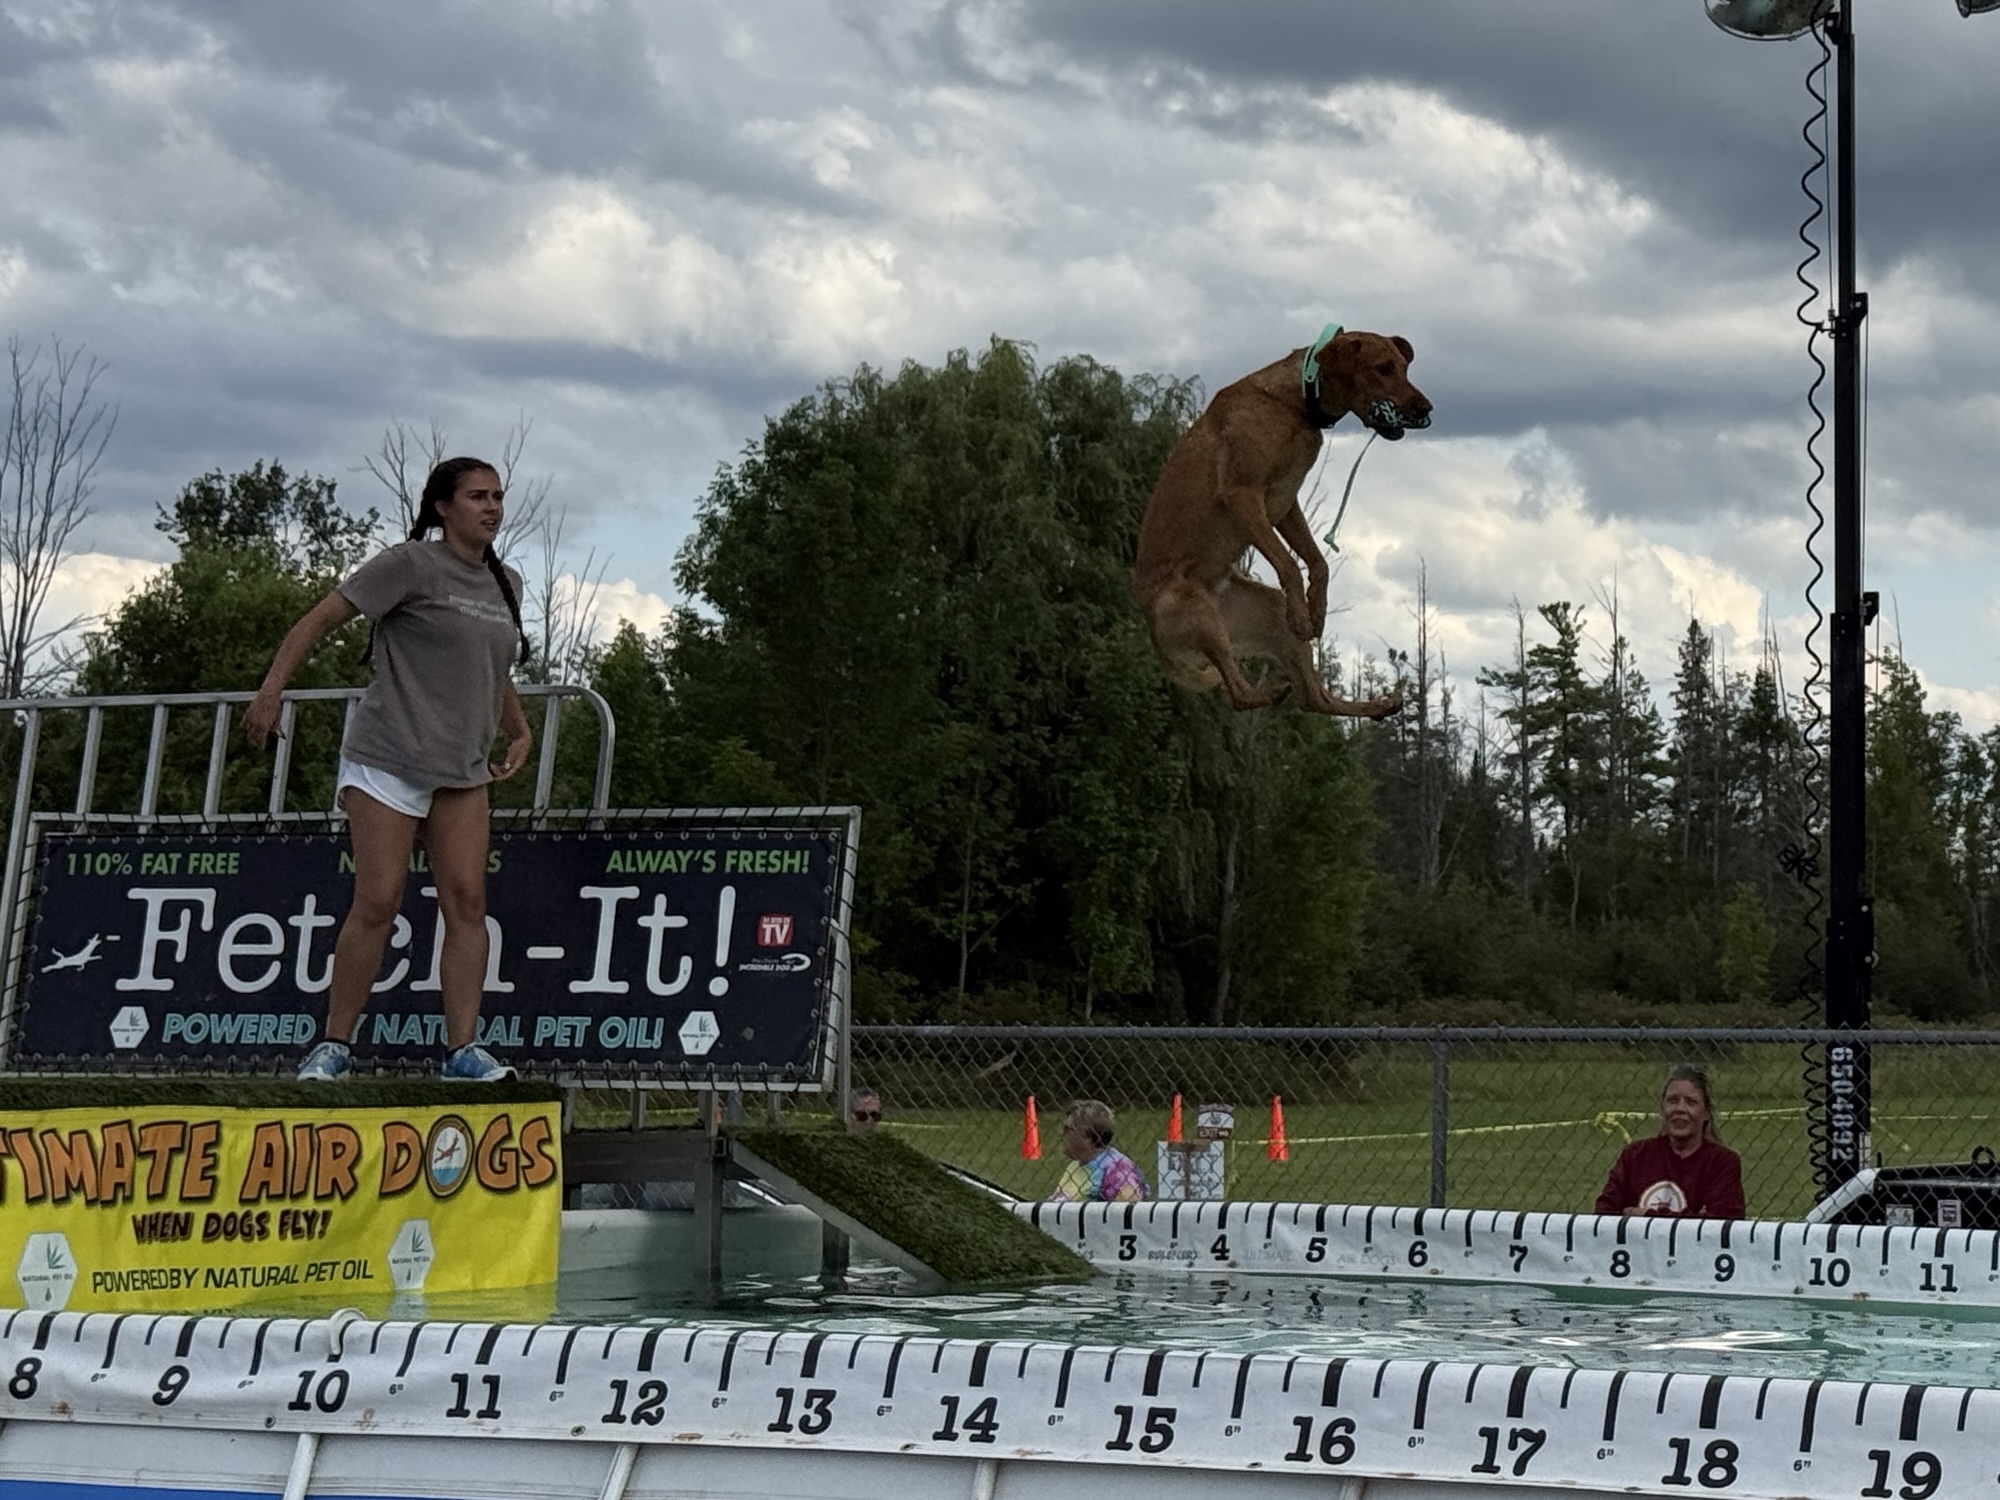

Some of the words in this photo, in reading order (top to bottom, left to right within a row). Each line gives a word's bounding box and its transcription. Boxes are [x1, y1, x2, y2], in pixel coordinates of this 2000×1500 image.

[67, 853, 133, 876] 110%
[140, 853, 182, 875] FAT
[187, 852, 240, 875] FREE
[605, 850, 717, 873] ALWAY'S
[724, 850, 810, 873] FRESH!
[762, 924, 791, 945] TV
[162, 1013, 315, 1044] POWERED
[533, 1016, 592, 1047] PET
[599, 1017, 664, 1049] OIL!
[1831, 1047, 1853, 1160] 6504892
[239, 1119, 361, 1201] AIR
[379, 1113, 555, 1198] DOGS
[132, 1211, 194, 1243] WHEN
[202, 1211, 269, 1242] DOGS
[278, 1209, 332, 1240] FLY!
[93, 1268, 199, 1293] POWEREDBY
[204, 1264, 299, 1288] NATURAL
[305, 1261, 339, 1282] PET
[342, 1259, 374, 1279] OIL
[1119, 1235, 1137, 1261] 3
[1211, 1235, 1229, 1260] 4
[1306, 1238, 1327, 1262] 5
[1408, 1241, 1427, 1267] 6
[1510, 1245, 1528, 1272] 7
[1610, 1250, 1630, 1277] 8
[1715, 1254, 1734, 1282] 9
[1809, 1258, 1850, 1287] 10
[1920, 1263, 1957, 1292] 11
[9, 1358, 41, 1399] 8
[152, 1366, 189, 1406] 9
[288, 1370, 349, 1413] 10
[389, 1383, 404, 1396] 6"
[446, 1373, 501, 1419] 11
[602, 1380, 667, 1425] 12
[711, 1397, 727, 1409] 6"
[768, 1388, 836, 1434] 13
[876, 1405, 893, 1417] 6"
[933, 1396, 999, 1443] 14
[1047, 1414, 1064, 1426] 6"
[1106, 1405, 1176, 1453] 15
[1224, 1425, 1241, 1437] 6"
[1285, 1416, 1355, 1464] 16
[1407, 1436, 1425, 1448] 6"
[1472, 1427, 1546, 1476] 17
[1596, 1448, 1614, 1460] 6"
[1662, 1438, 1739, 1488] 18
[1793, 1459, 1812, 1472] 6"
[1861, 1450, 1941, 1500] 19
